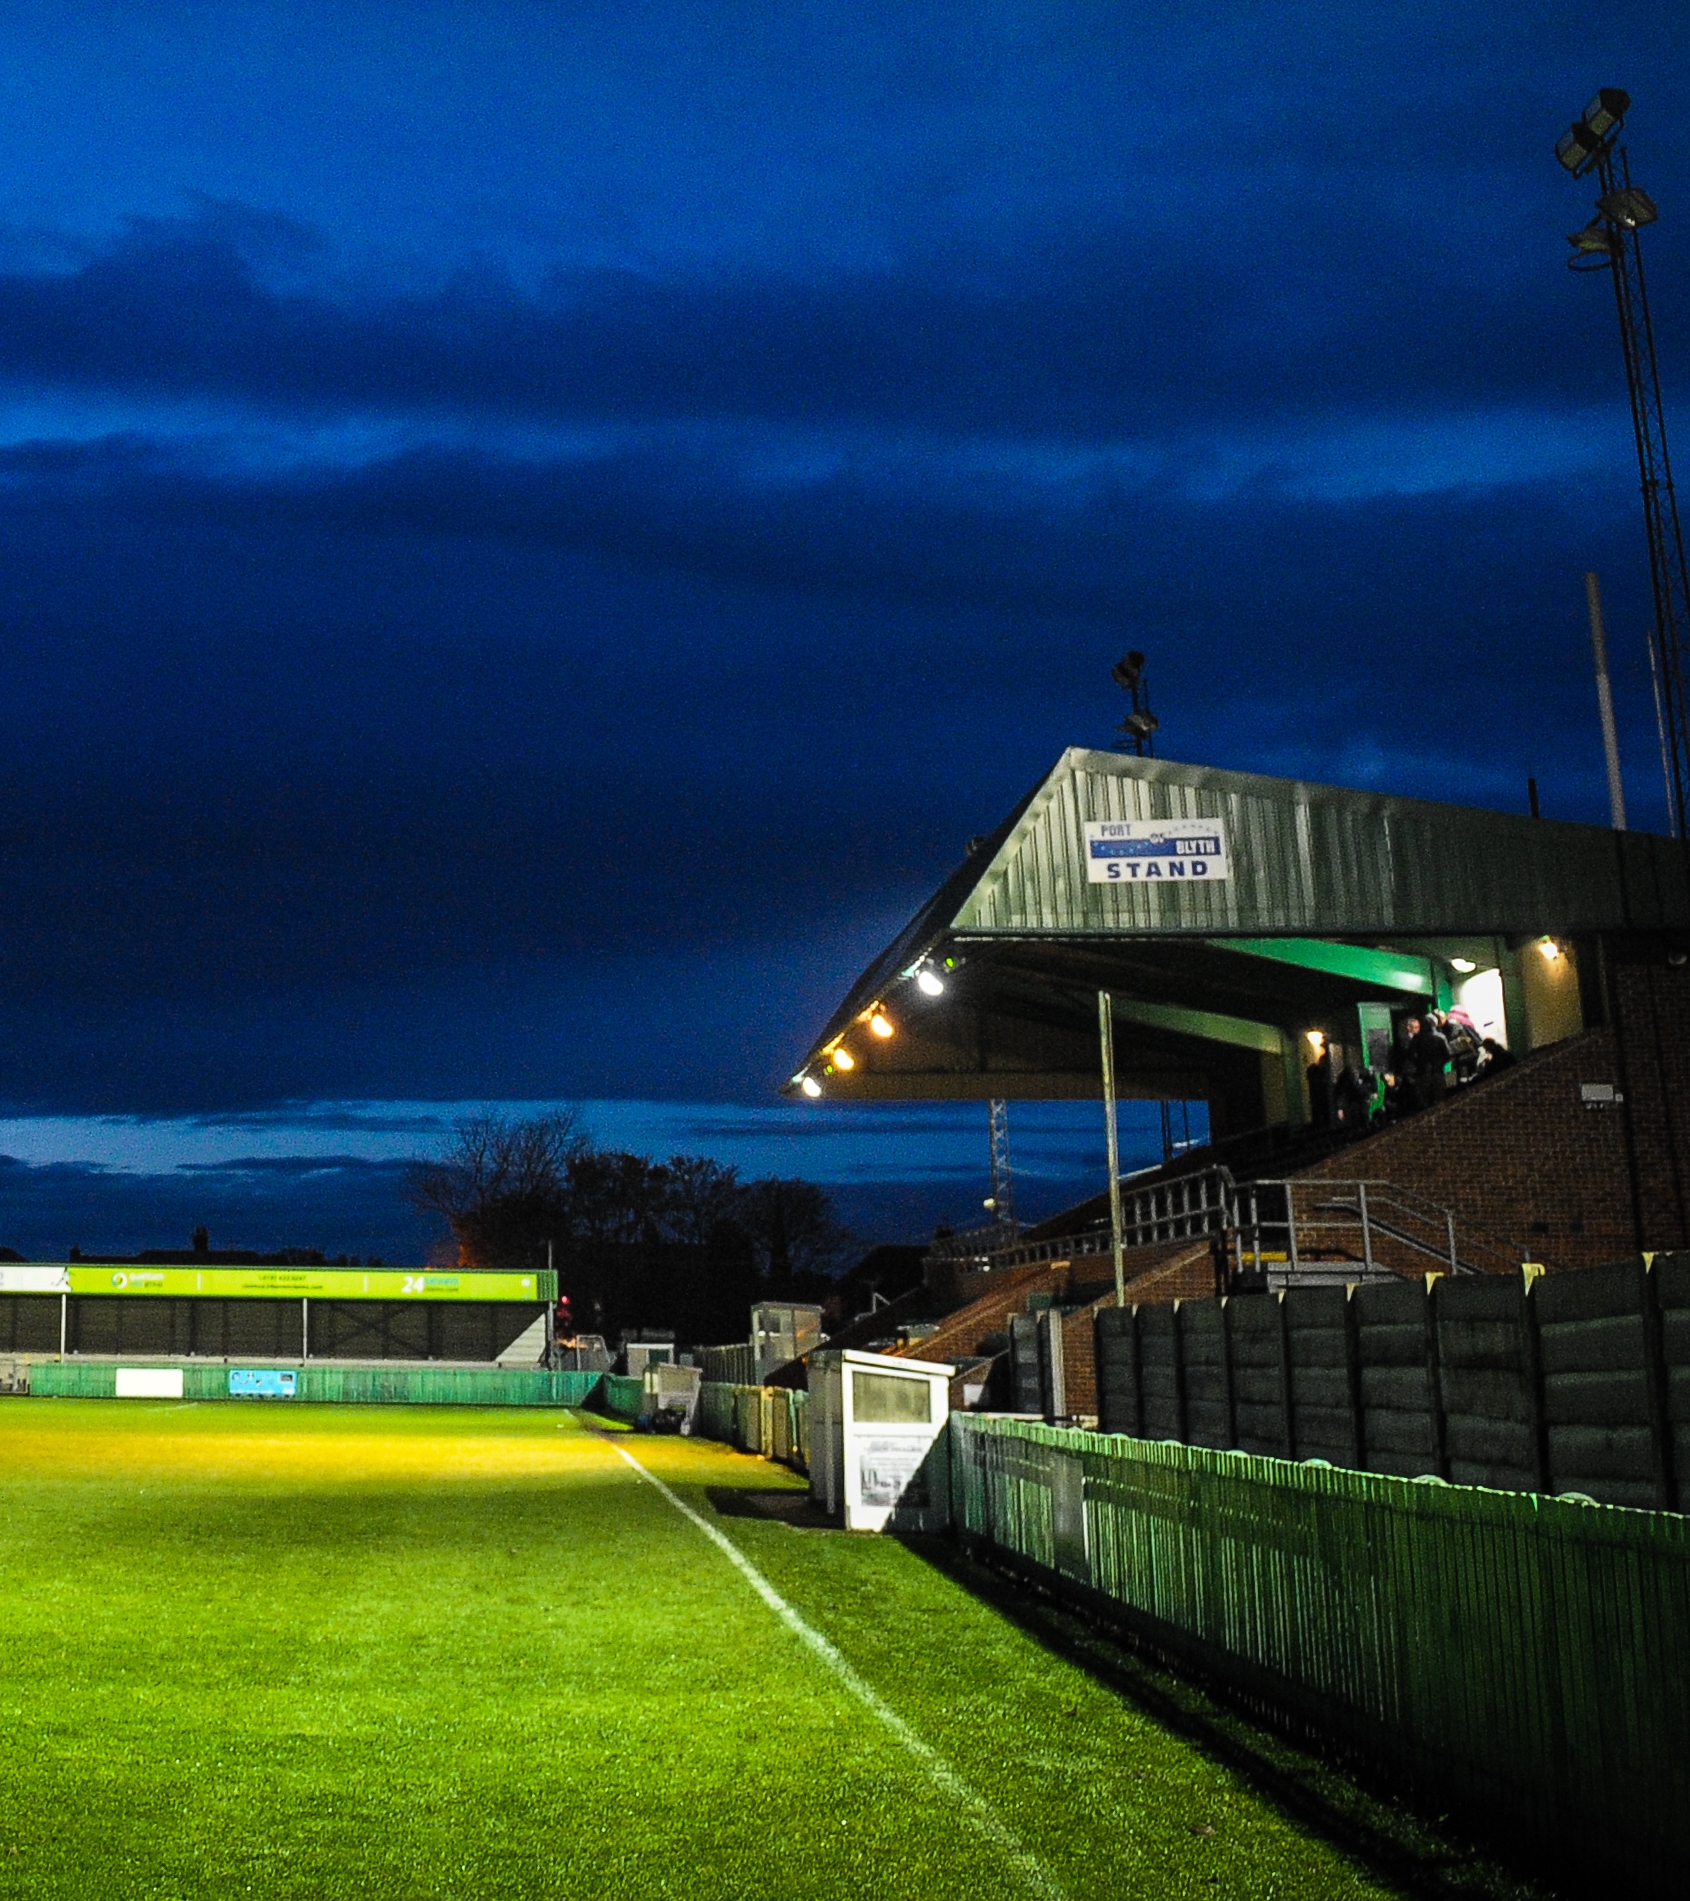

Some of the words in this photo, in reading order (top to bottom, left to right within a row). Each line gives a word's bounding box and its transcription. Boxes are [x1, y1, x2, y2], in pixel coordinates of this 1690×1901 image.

[1101, 824, 1131, 836] PORT
[1176, 840, 1215, 854] BLYTH
[1108, 861, 1208, 878] STAND
